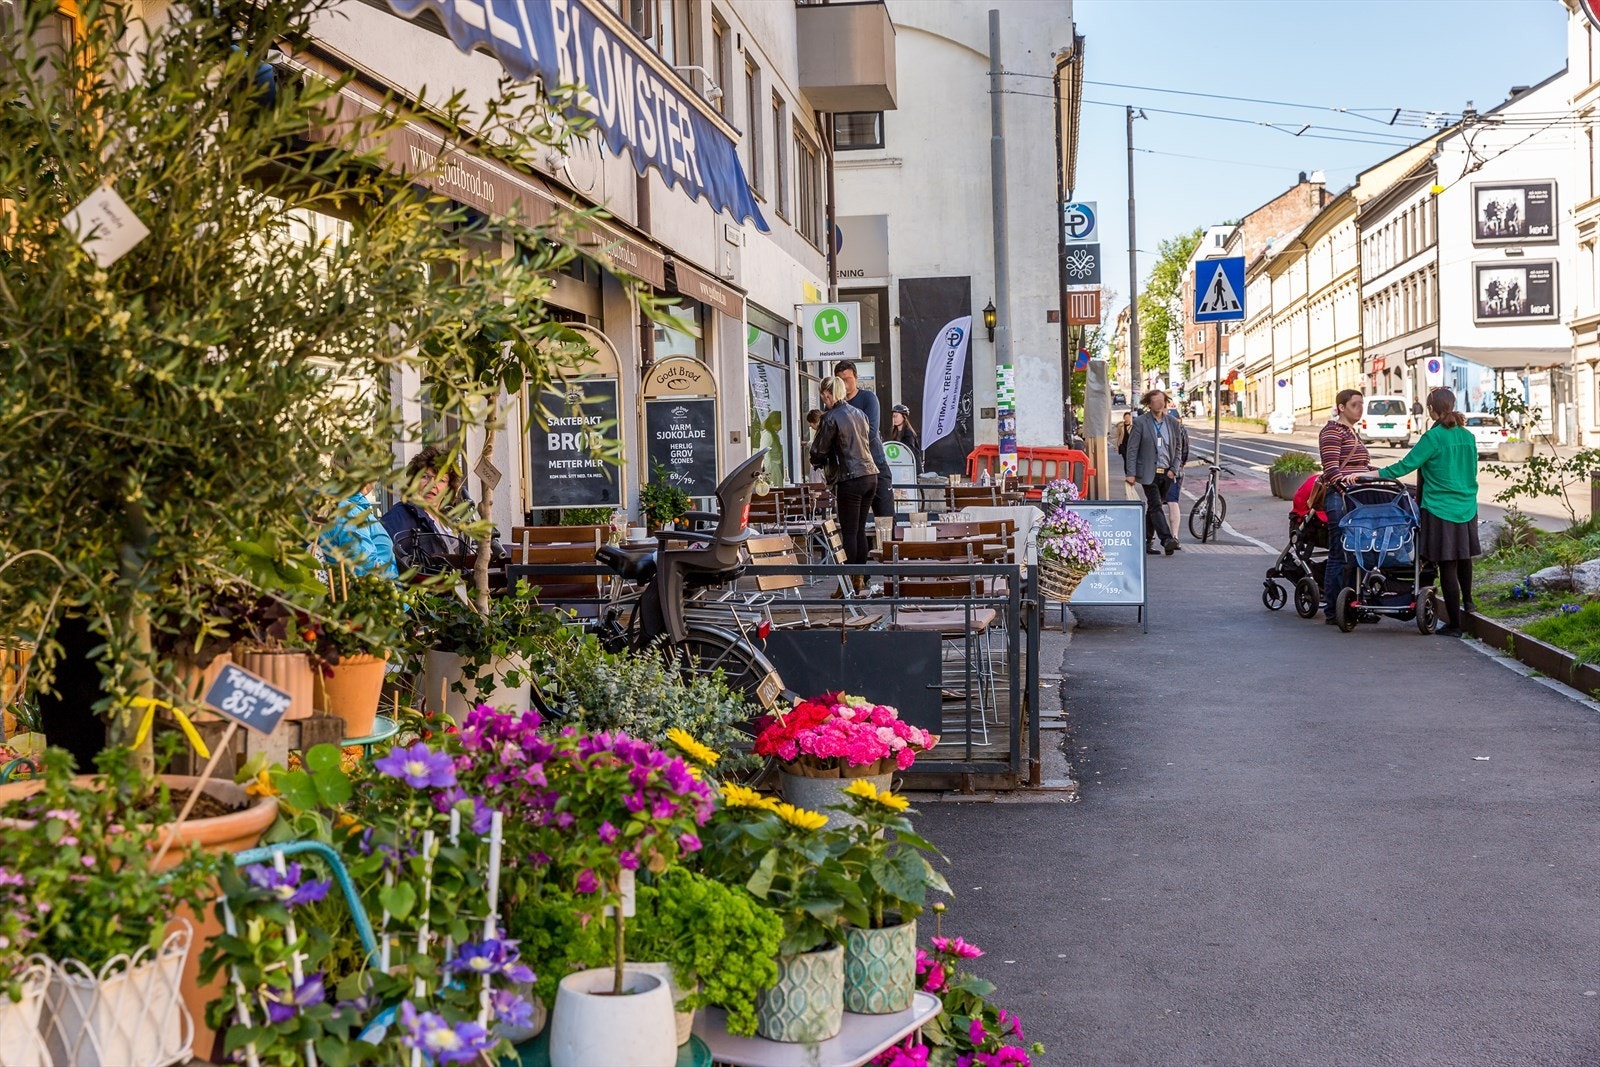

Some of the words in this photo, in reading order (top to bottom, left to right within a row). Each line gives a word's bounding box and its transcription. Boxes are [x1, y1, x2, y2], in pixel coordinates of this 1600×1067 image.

[821, 315, 841, 337] H
[656, 366, 677, 384] Godt
[679, 366, 701, 382] Brød
[937, 395, 948, 435] OPTIMAL
[943, 350, 955, 393] TRENING
[547, 416, 602, 427] SAKTEBAKT
[547, 431, 604, 452] BRØD
[656, 430, 706, 440] SJOKOLADE
[670, 450, 694, 458] GROV
[548, 460, 583, 469] METTER
